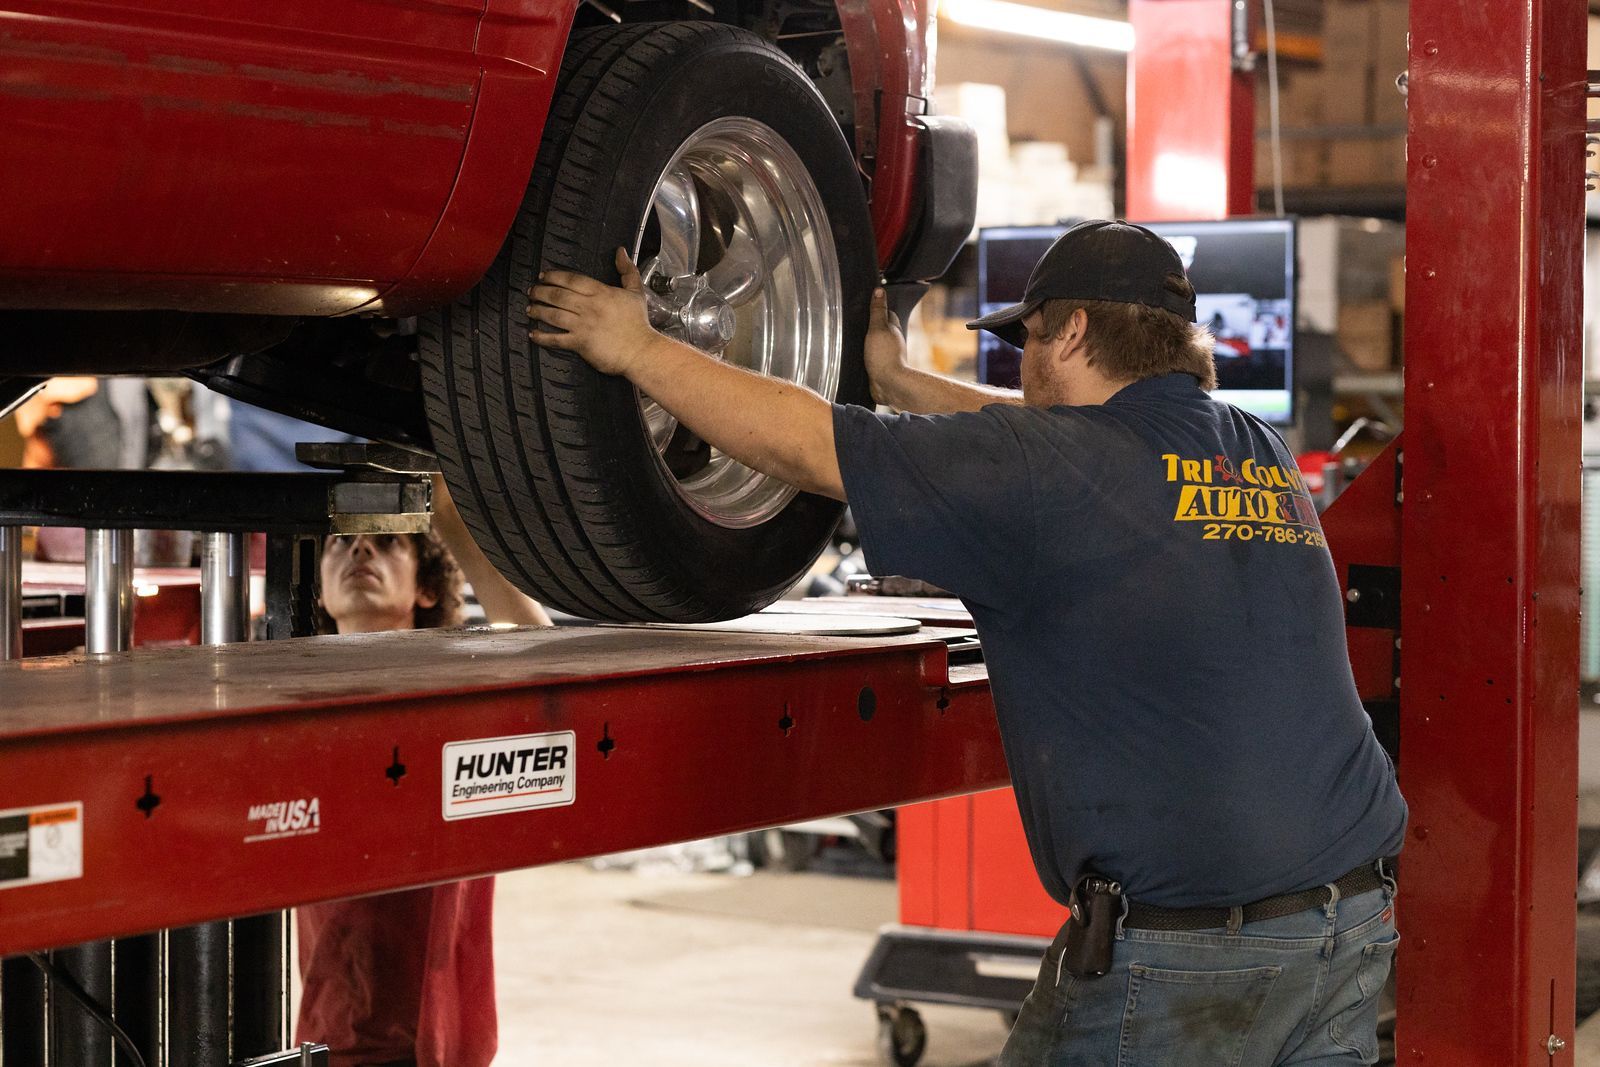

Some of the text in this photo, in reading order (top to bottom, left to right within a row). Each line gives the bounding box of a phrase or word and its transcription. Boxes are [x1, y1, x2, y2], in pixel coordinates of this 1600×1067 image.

[1161, 453, 1213, 484] TRI
[1181, 487, 1270, 519] AUTO
[455, 745, 568, 781] HUNTER
[452, 775, 566, 799] Engineering Company
[247, 797, 321, 832] MADE USA
[265, 818, 279, 834] IN
